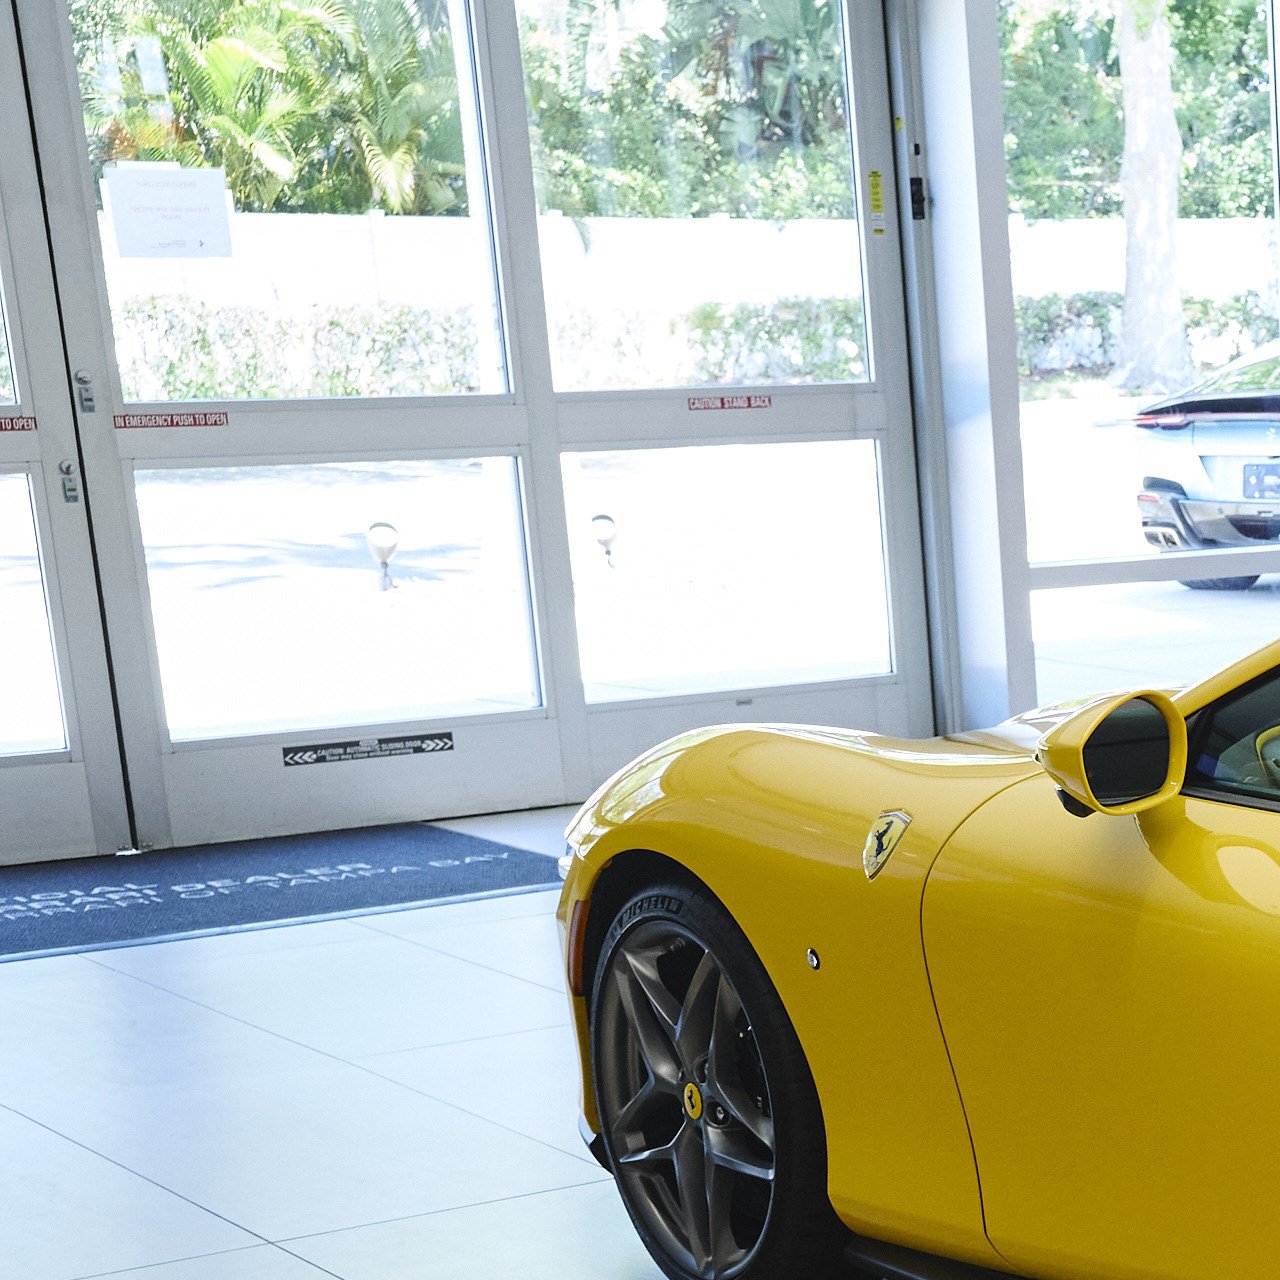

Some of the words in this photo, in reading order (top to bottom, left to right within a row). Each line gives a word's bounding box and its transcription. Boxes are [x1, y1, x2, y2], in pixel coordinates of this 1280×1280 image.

[1, 418, 12, 430] TO
[13, 418, 36, 430] OPEN
[115, 416, 125, 428] IN
[125, 415, 172, 427] EMERGENCY
[172, 414, 194, 426] PUSH
[195, 414, 205, 425] TO
[205, 413, 227, 425] OPEN
[170, 862, 372, 893] DEALER
[180, 885, 243, 899] OF
[253, 865, 421, 889] TAMPA
[427, 851, 509, 868] BAY
[621, 896, 681, 923] MICHELIN
